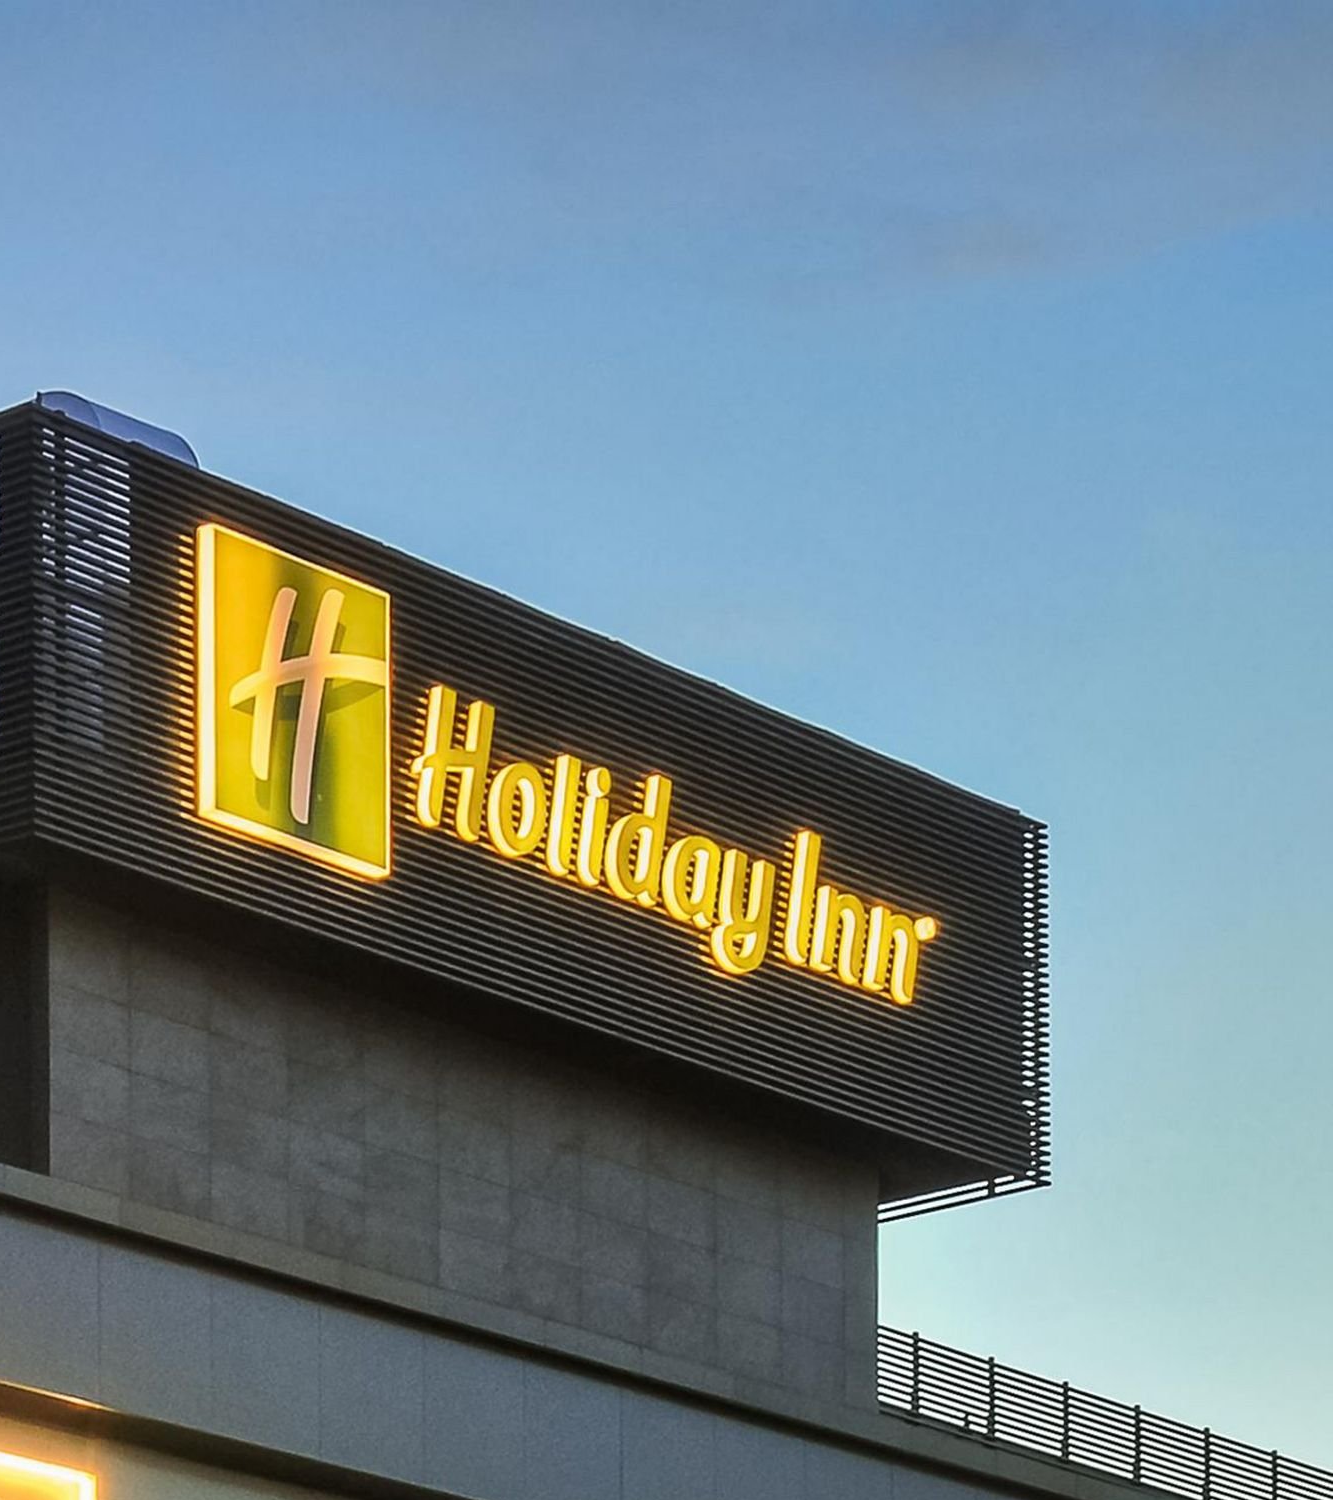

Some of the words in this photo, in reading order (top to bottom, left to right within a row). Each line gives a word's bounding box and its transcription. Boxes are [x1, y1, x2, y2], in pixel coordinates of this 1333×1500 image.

[229, 586, 389, 826] H
[411, 684, 775, 976] Holiday
[783, 828, 921, 1006] Inn
